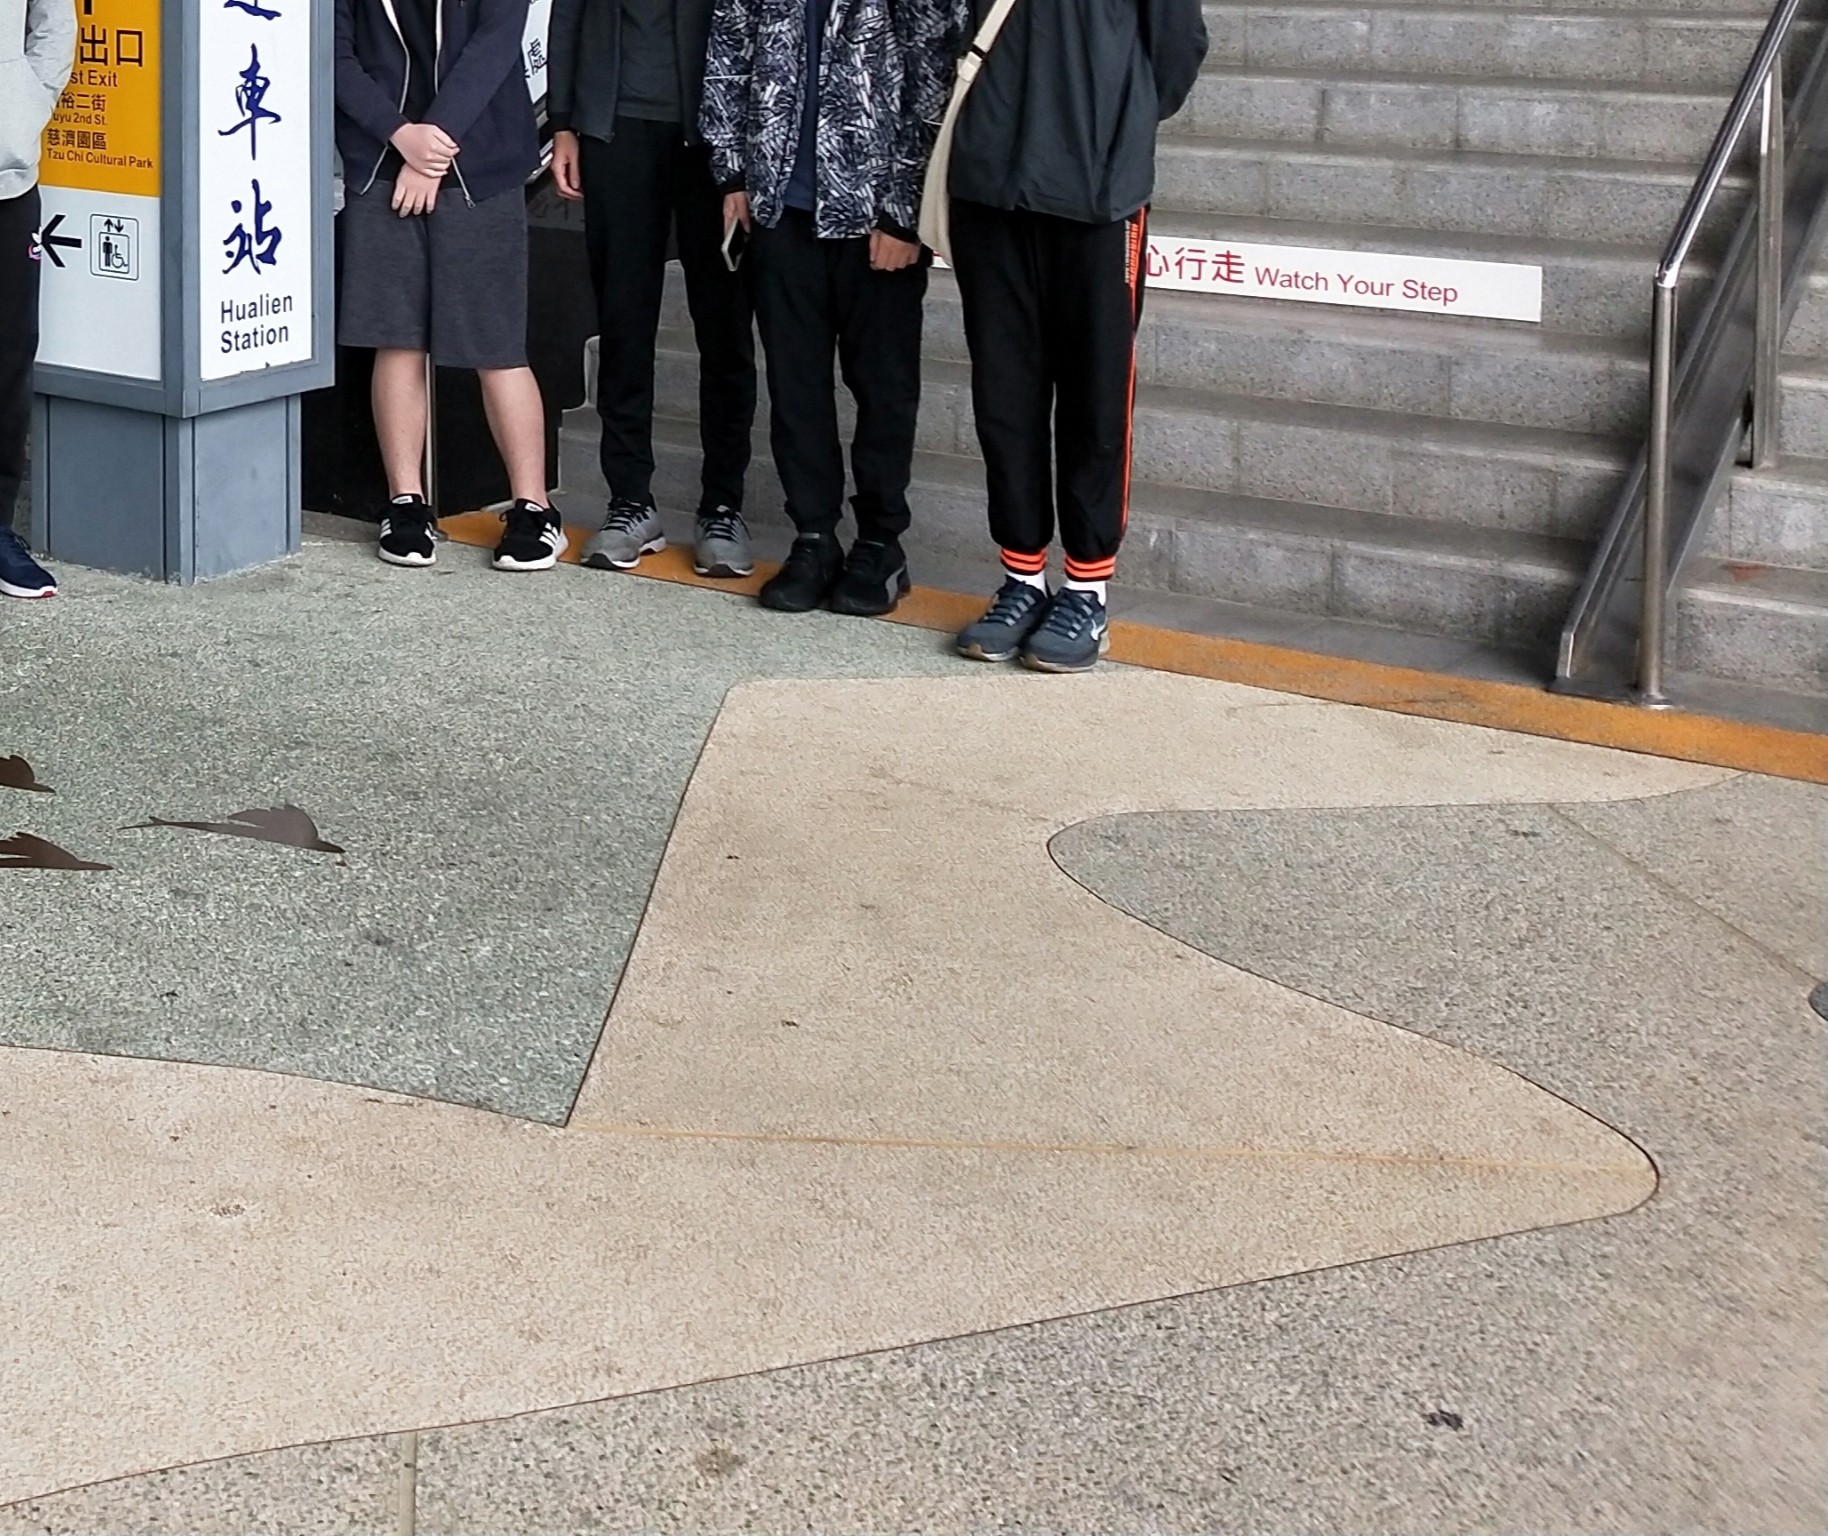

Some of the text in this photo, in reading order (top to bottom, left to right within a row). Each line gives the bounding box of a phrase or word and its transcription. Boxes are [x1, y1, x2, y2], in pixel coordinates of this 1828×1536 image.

[80, 25, 143, 67] 出口
[88, 70, 118, 87] Exit
[56, 91, 107, 112] 裕二街
[53, 113, 72, 124] uyu
[73, 113, 92, 124] 2nd
[47, 128, 107, 150] 慈濟園區
[46, 148, 154, 169] Tzu Chi Cultural Park
[1146, 244, 1245, 284] 心行走
[1255, 266, 1459, 304] Watch Your Step
[221, 293, 293, 324] Hualien
[221, 325, 289, 354] Station
